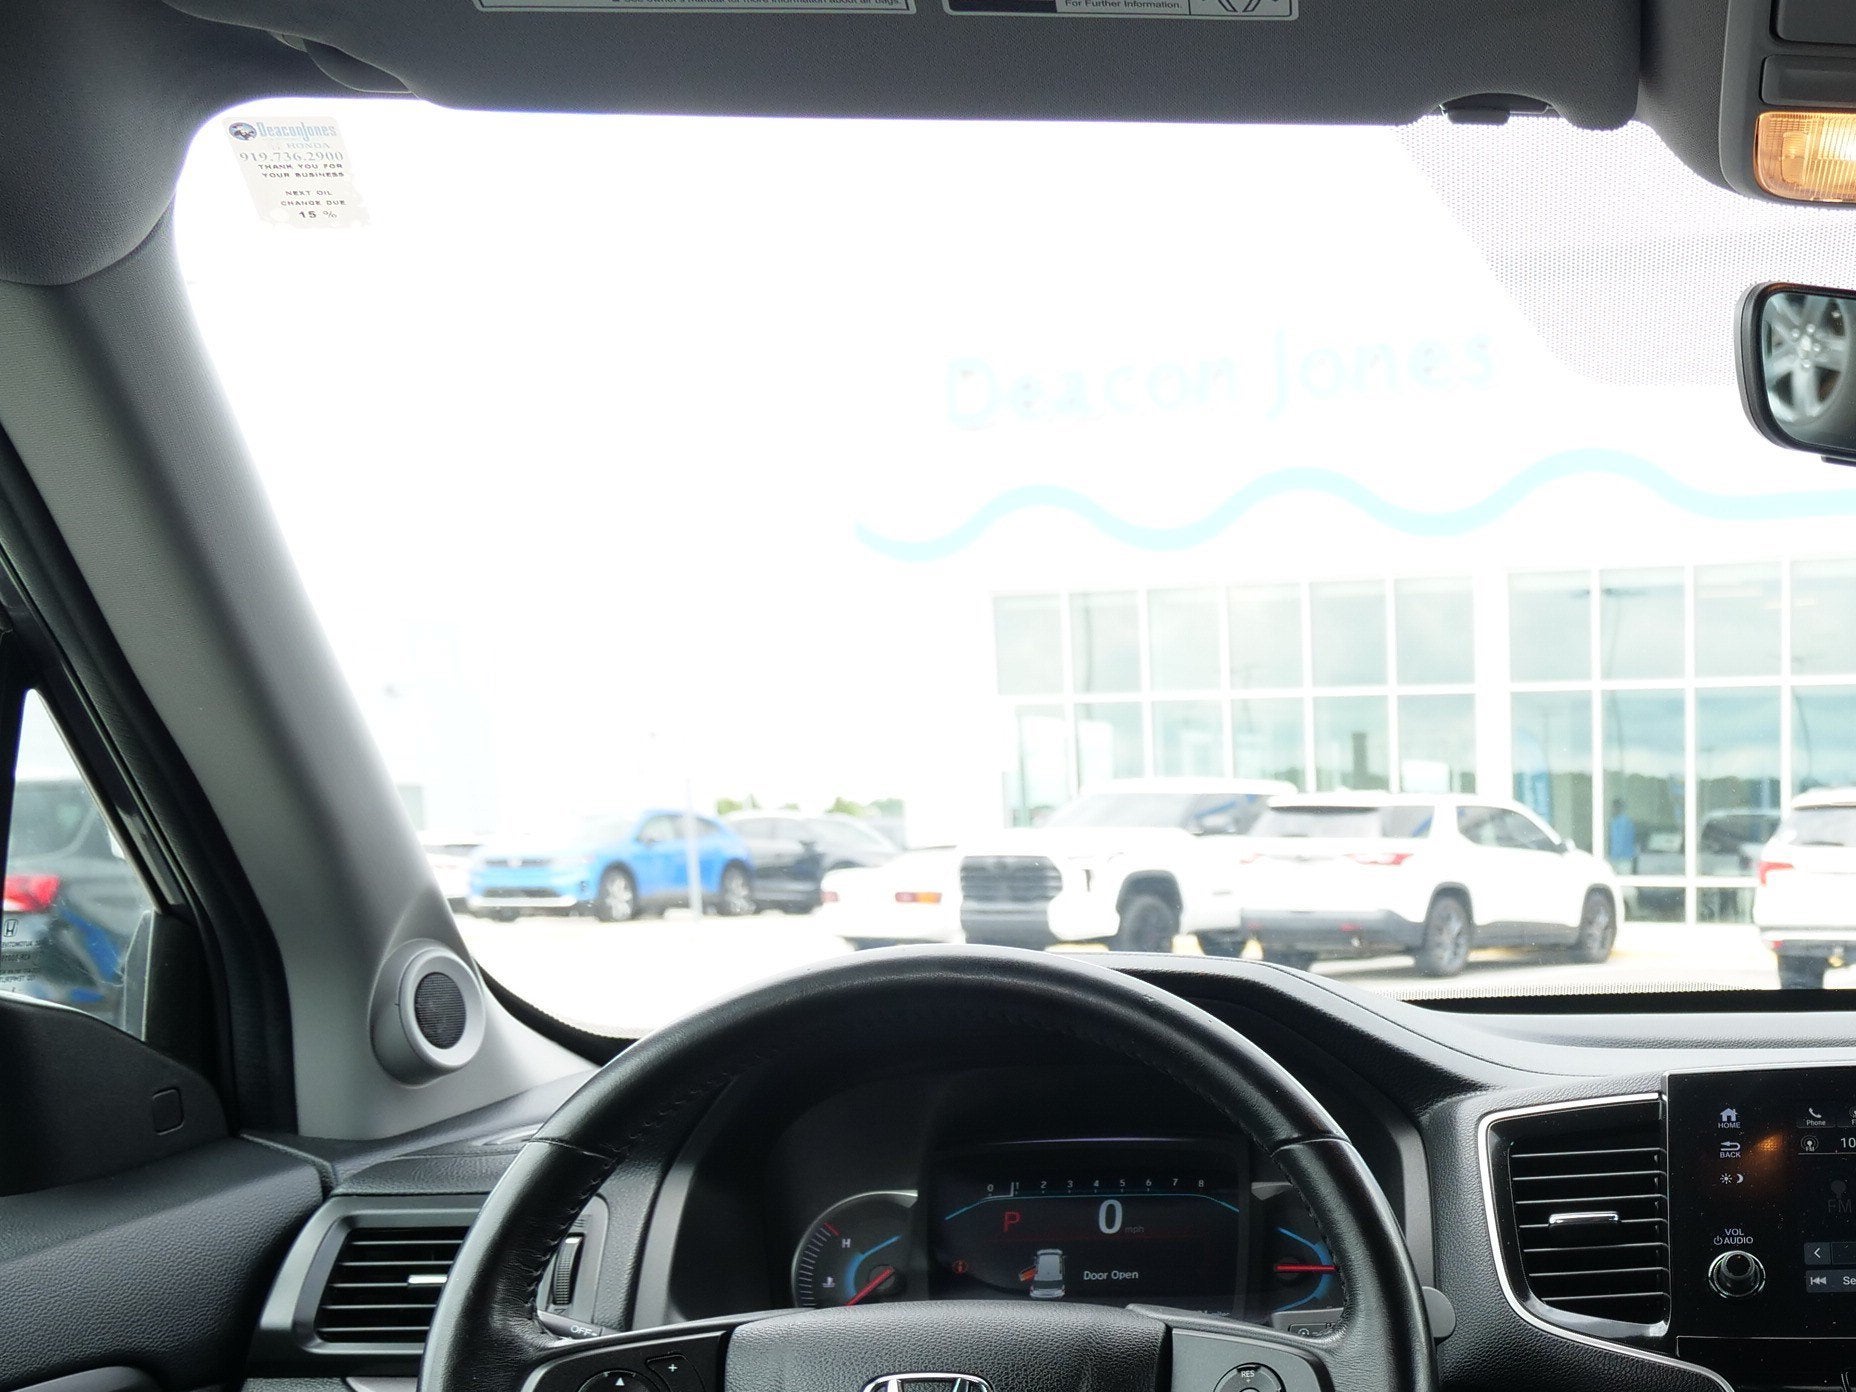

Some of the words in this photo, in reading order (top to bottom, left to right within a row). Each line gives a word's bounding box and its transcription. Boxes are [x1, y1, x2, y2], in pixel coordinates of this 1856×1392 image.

[1086, 0, 1121, 8] Further
[1124, 0, 1183, 9] Information.
[239, 151, 344, 162] 919.736.2900
[299, 210, 317, 219] 15
[323, 210, 338, 219] %
[945, 355, 1240, 432] Deacon
[1263, 326, 1497, 422] Jones
[1718, 1121, 1741, 1129] HOME
[1806, 1119, 1826, 1127] Phone
[1719, 1151, 1741, 1159] BACK
[987, 1184, 994, 1192] 0
[1015, 1182, 1020, 1190] 1
[1040, 1181, 1048, 1189] 2
[1067, 1180, 1074, 1188] 3
[1093, 1180, 1100, 1188] 4
[1119, 1179, 1126, 1187] 5
[1145, 1179, 1152, 1187] 6
[1172, 1178, 1179, 1186] 7
[1198, 1180, 1205, 1188] 8
[1003, 1211, 1021, 1232] P
[1098, 1200, 1123, 1235] 0
[1125, 1226, 1144, 1235] mph
[1724, 1228, 1745, 1236] VOL
[841, 1237, 851, 1249] H
[1724, 1236, 1754, 1245] AUDIO
[1084, 1269, 1108, 1280] Door
[1110, 1269, 1139, 1281] Open
